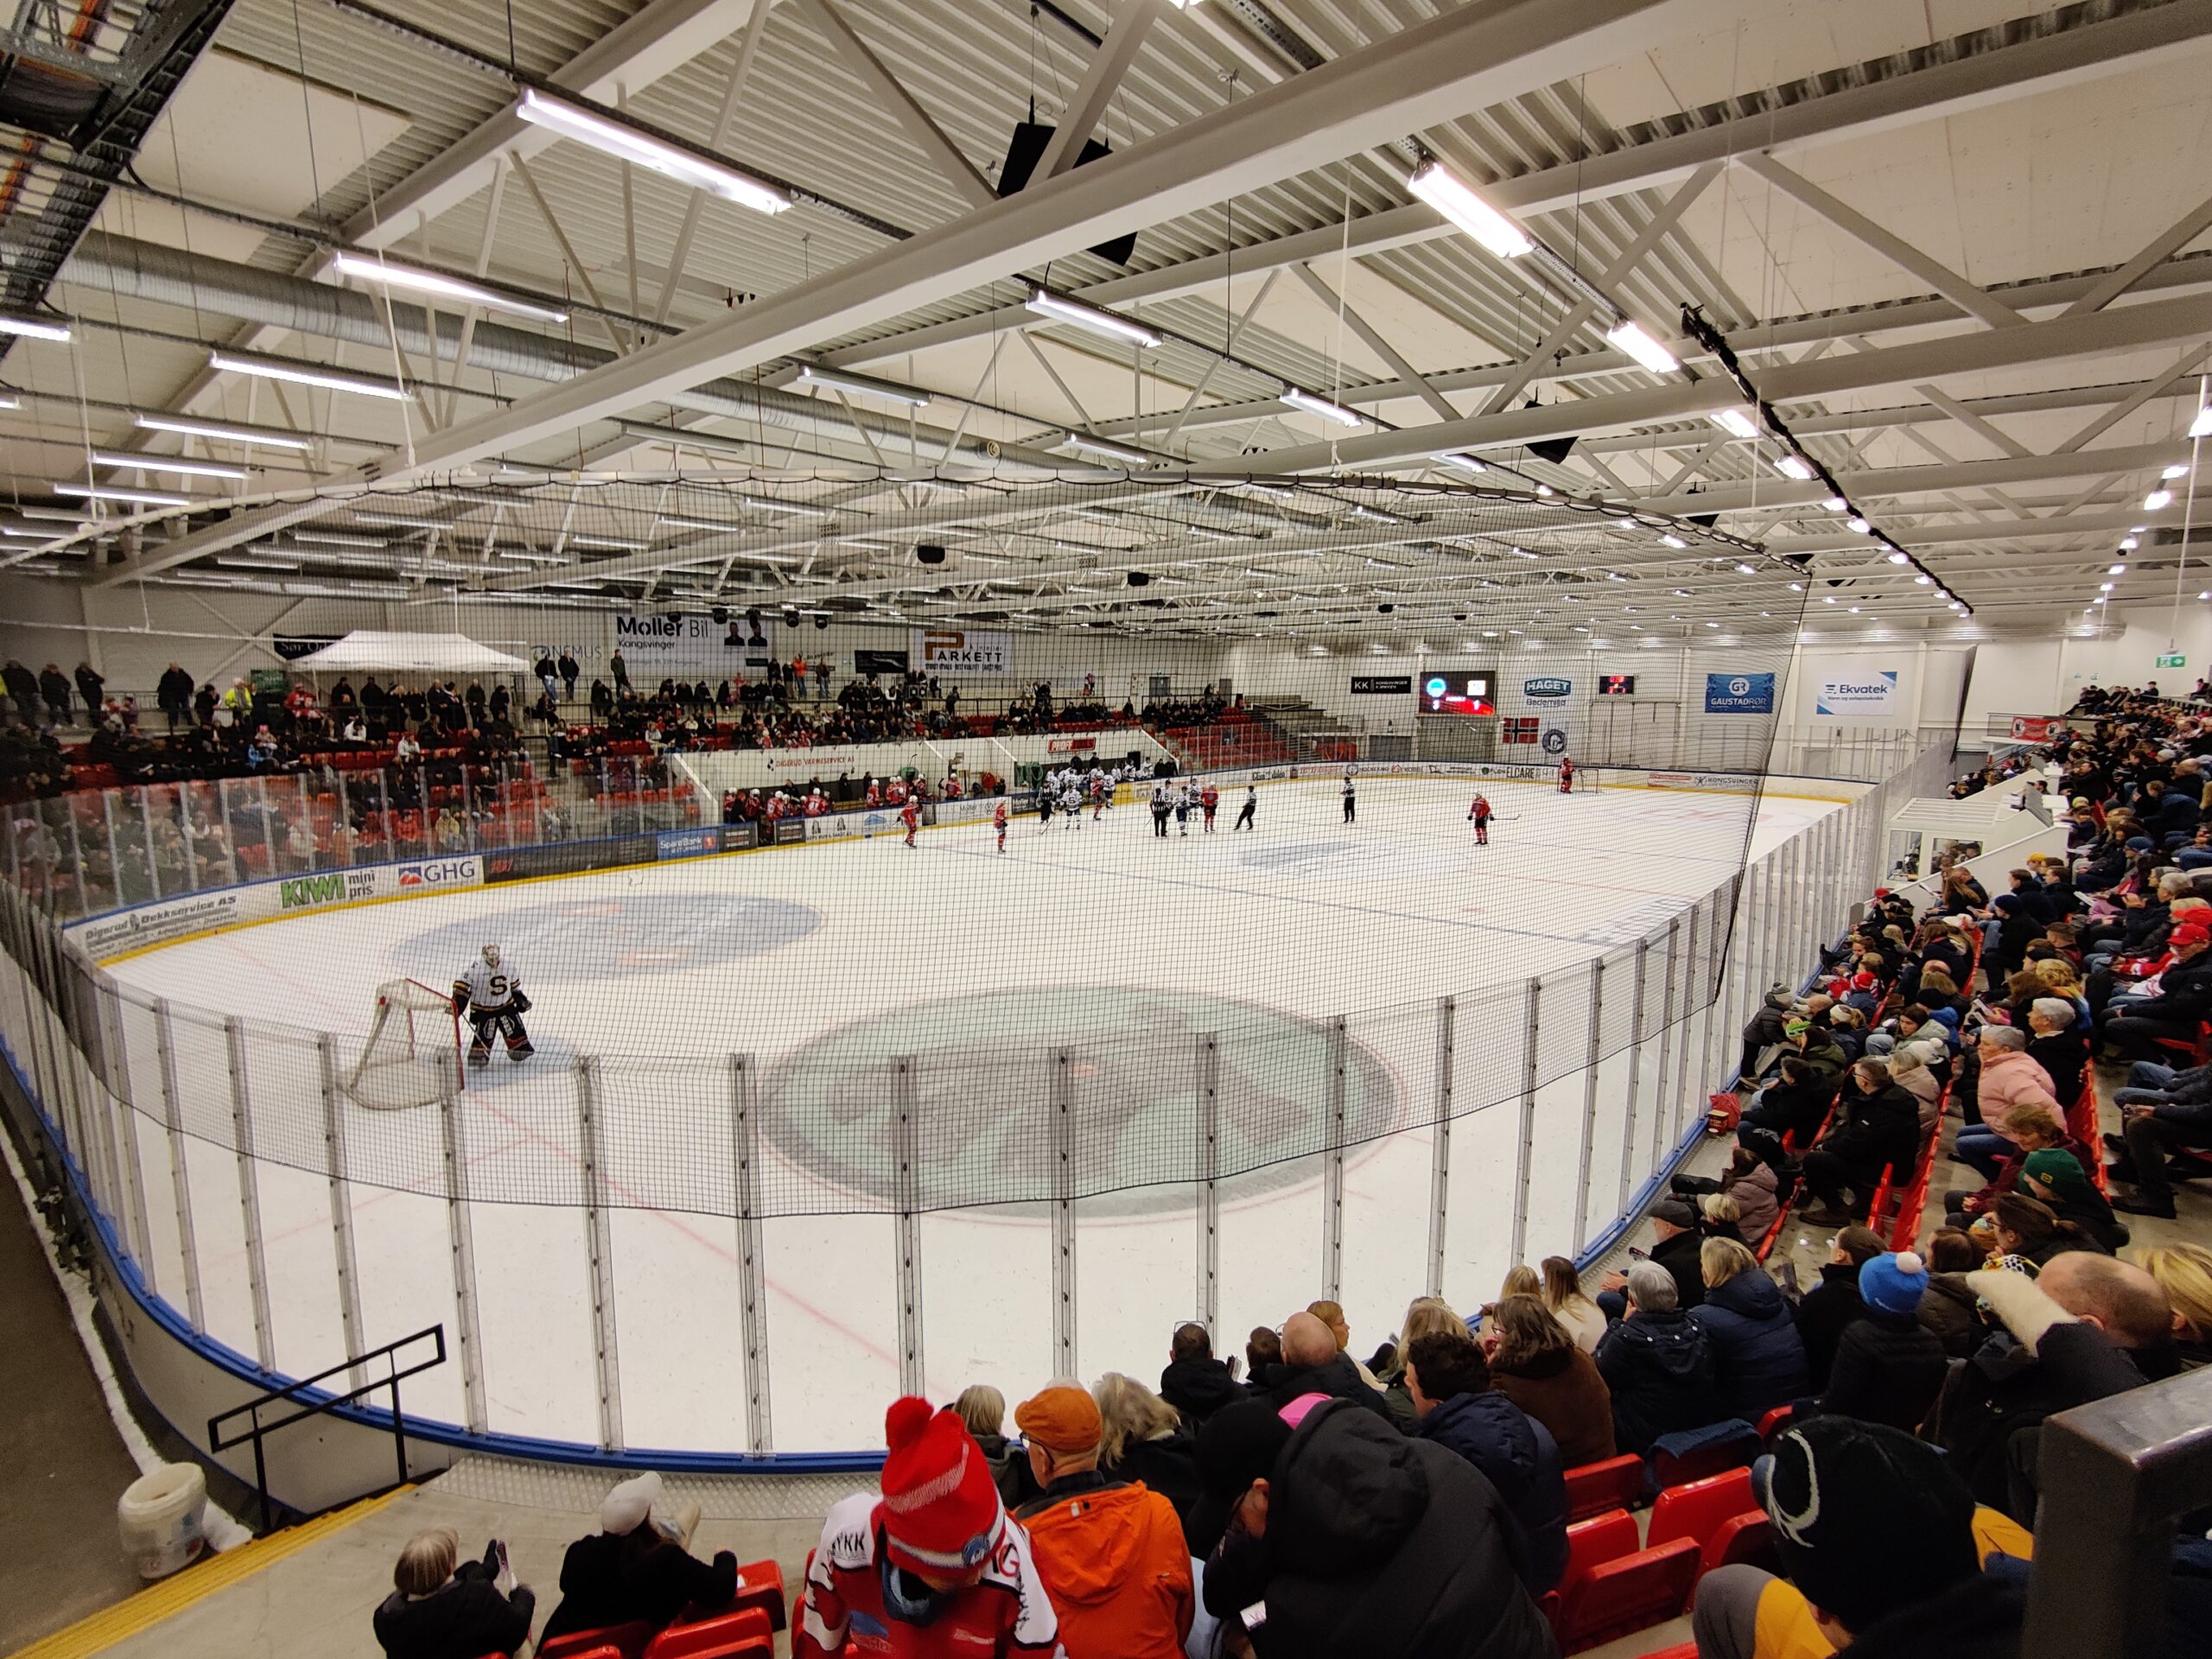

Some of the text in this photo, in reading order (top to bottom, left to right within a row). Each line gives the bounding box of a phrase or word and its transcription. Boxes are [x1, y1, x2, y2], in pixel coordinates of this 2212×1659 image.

[690, 620, 709, 638] Bil
[281, 642, 304, 652] Sør
[618, 640, 676, 651] Kongsvinger
[1354, 681, 1369, 690] KK
[1526, 681, 1569, 690] HAGET
[1732, 682, 1746, 692] GR
[1840, 684, 1888, 694] Ekvatek
[1527, 699, 1567, 708] Bademiljø
[1711, 697, 1767, 706] GAUSTADRØR
[776, 759, 802, 767] DIGERUD
[804, 757, 845, 766] VARMESERVICE
[1506, 766, 1535, 779] ELCARE
[1708, 777, 1758, 785] KONGSVINGER
[423, 861, 474, 882] GHG
[347, 870, 375, 886] mini
[280, 874, 345, 908] KIWI
[349, 883, 374, 900] pris
[141, 901, 214, 924] Dekkservice
[218, 895, 237, 906] AS
[489, 975, 507, 996] S
